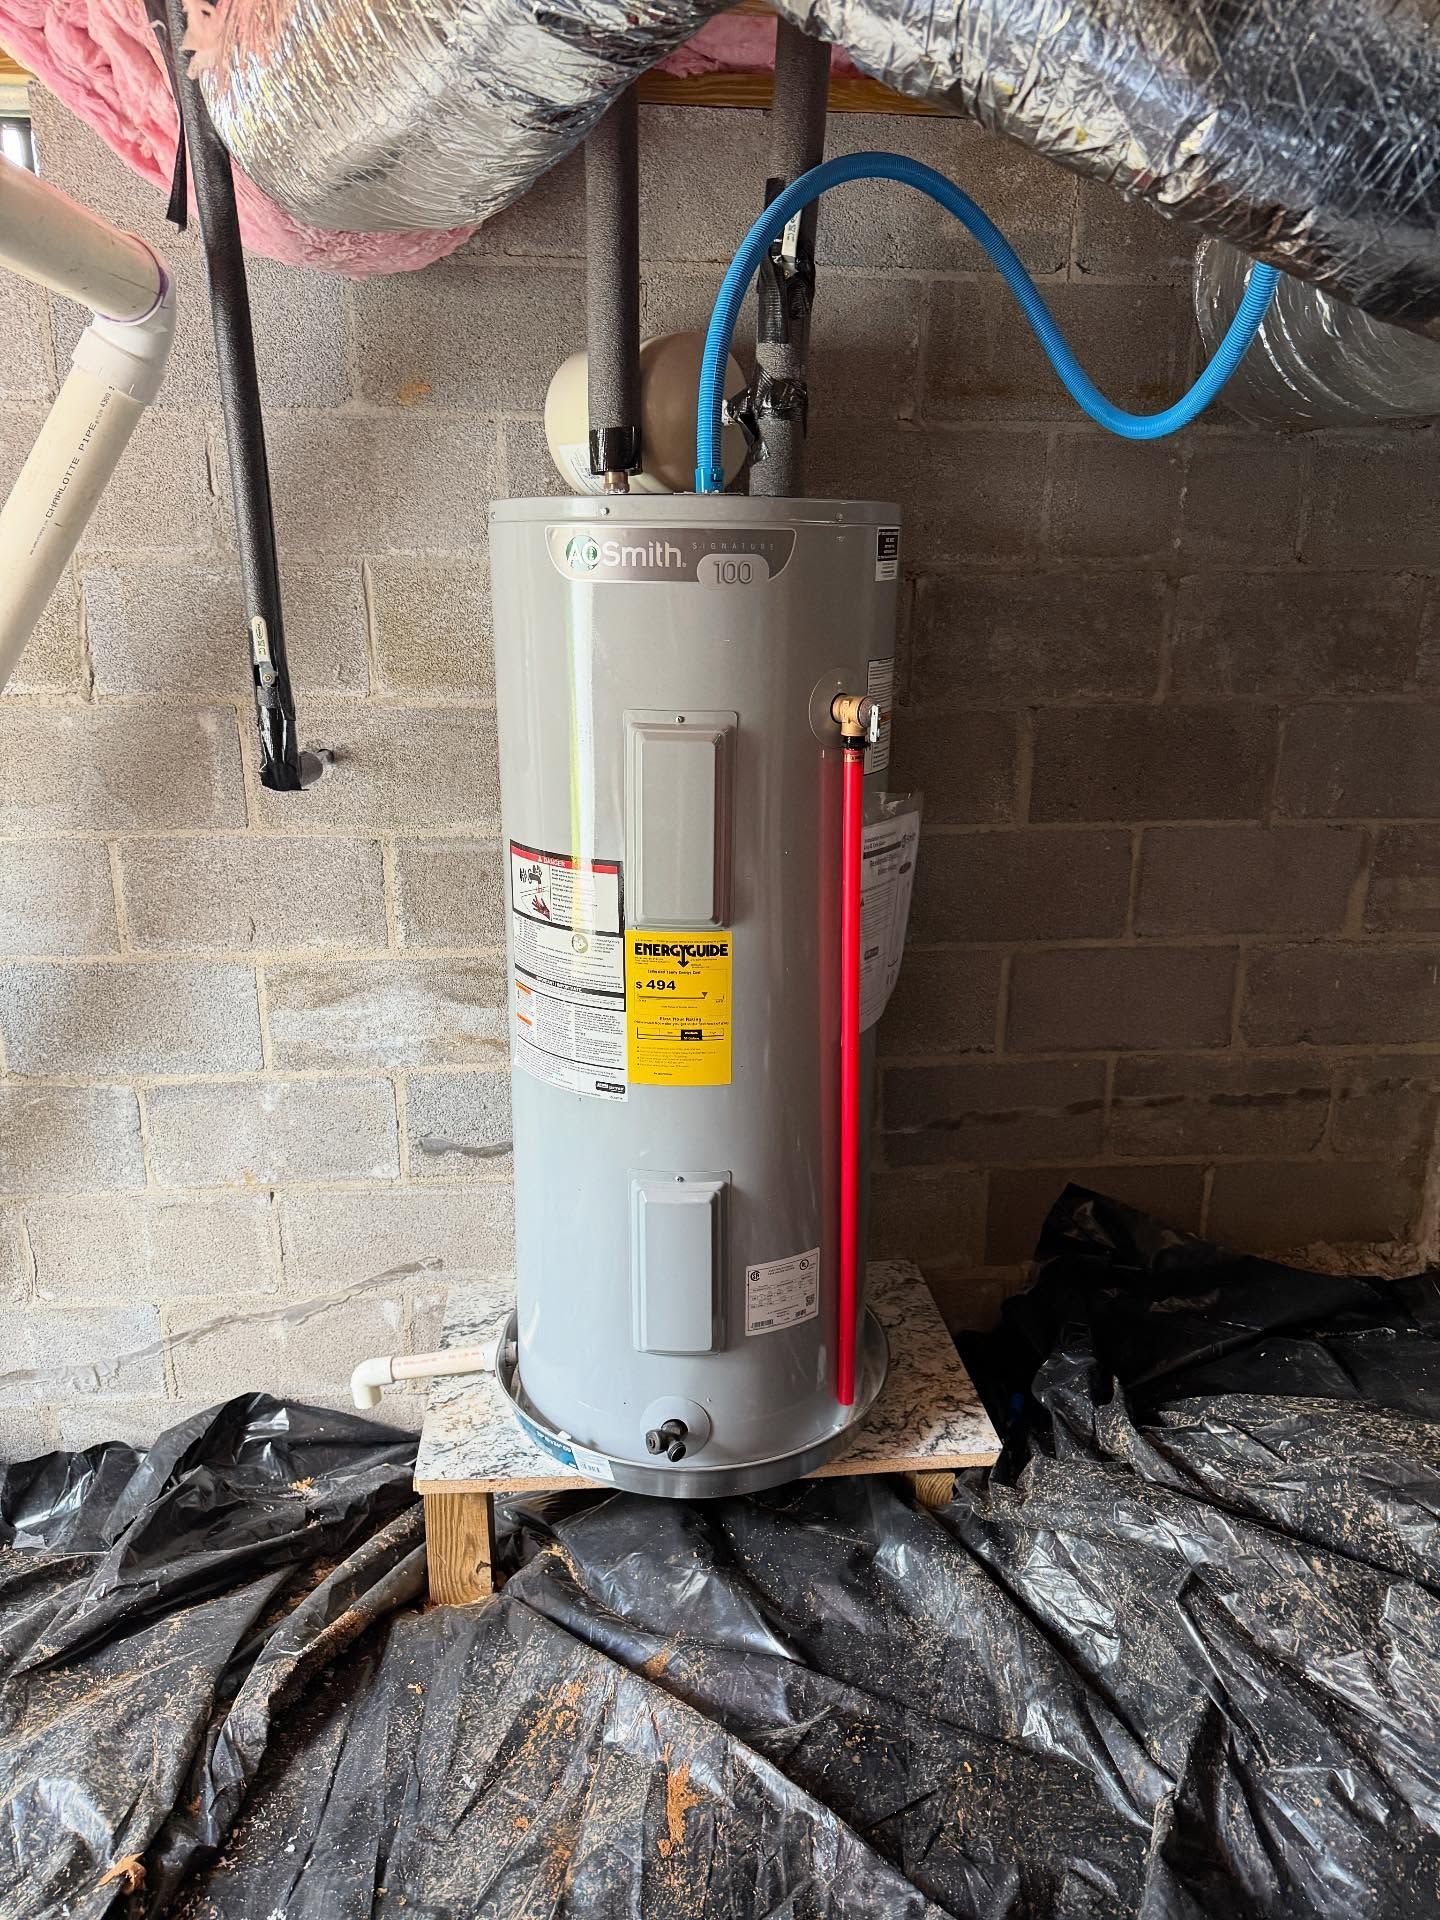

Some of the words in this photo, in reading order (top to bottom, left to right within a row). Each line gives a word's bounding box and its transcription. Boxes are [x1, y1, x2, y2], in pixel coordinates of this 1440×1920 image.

[45, 457, 80, 518] CHARLOTTE
[78, 422, 97, 451] PIPE
[691, 541, 776, 552] SIGNATURE
[713, 560, 755, 585] 100
[543, 856, 566, 868] DANGER
[635, 943, 729, 957] ENERGYGUIDE
[635, 981, 643, 990] $
[646, 979, 677, 991] 494
